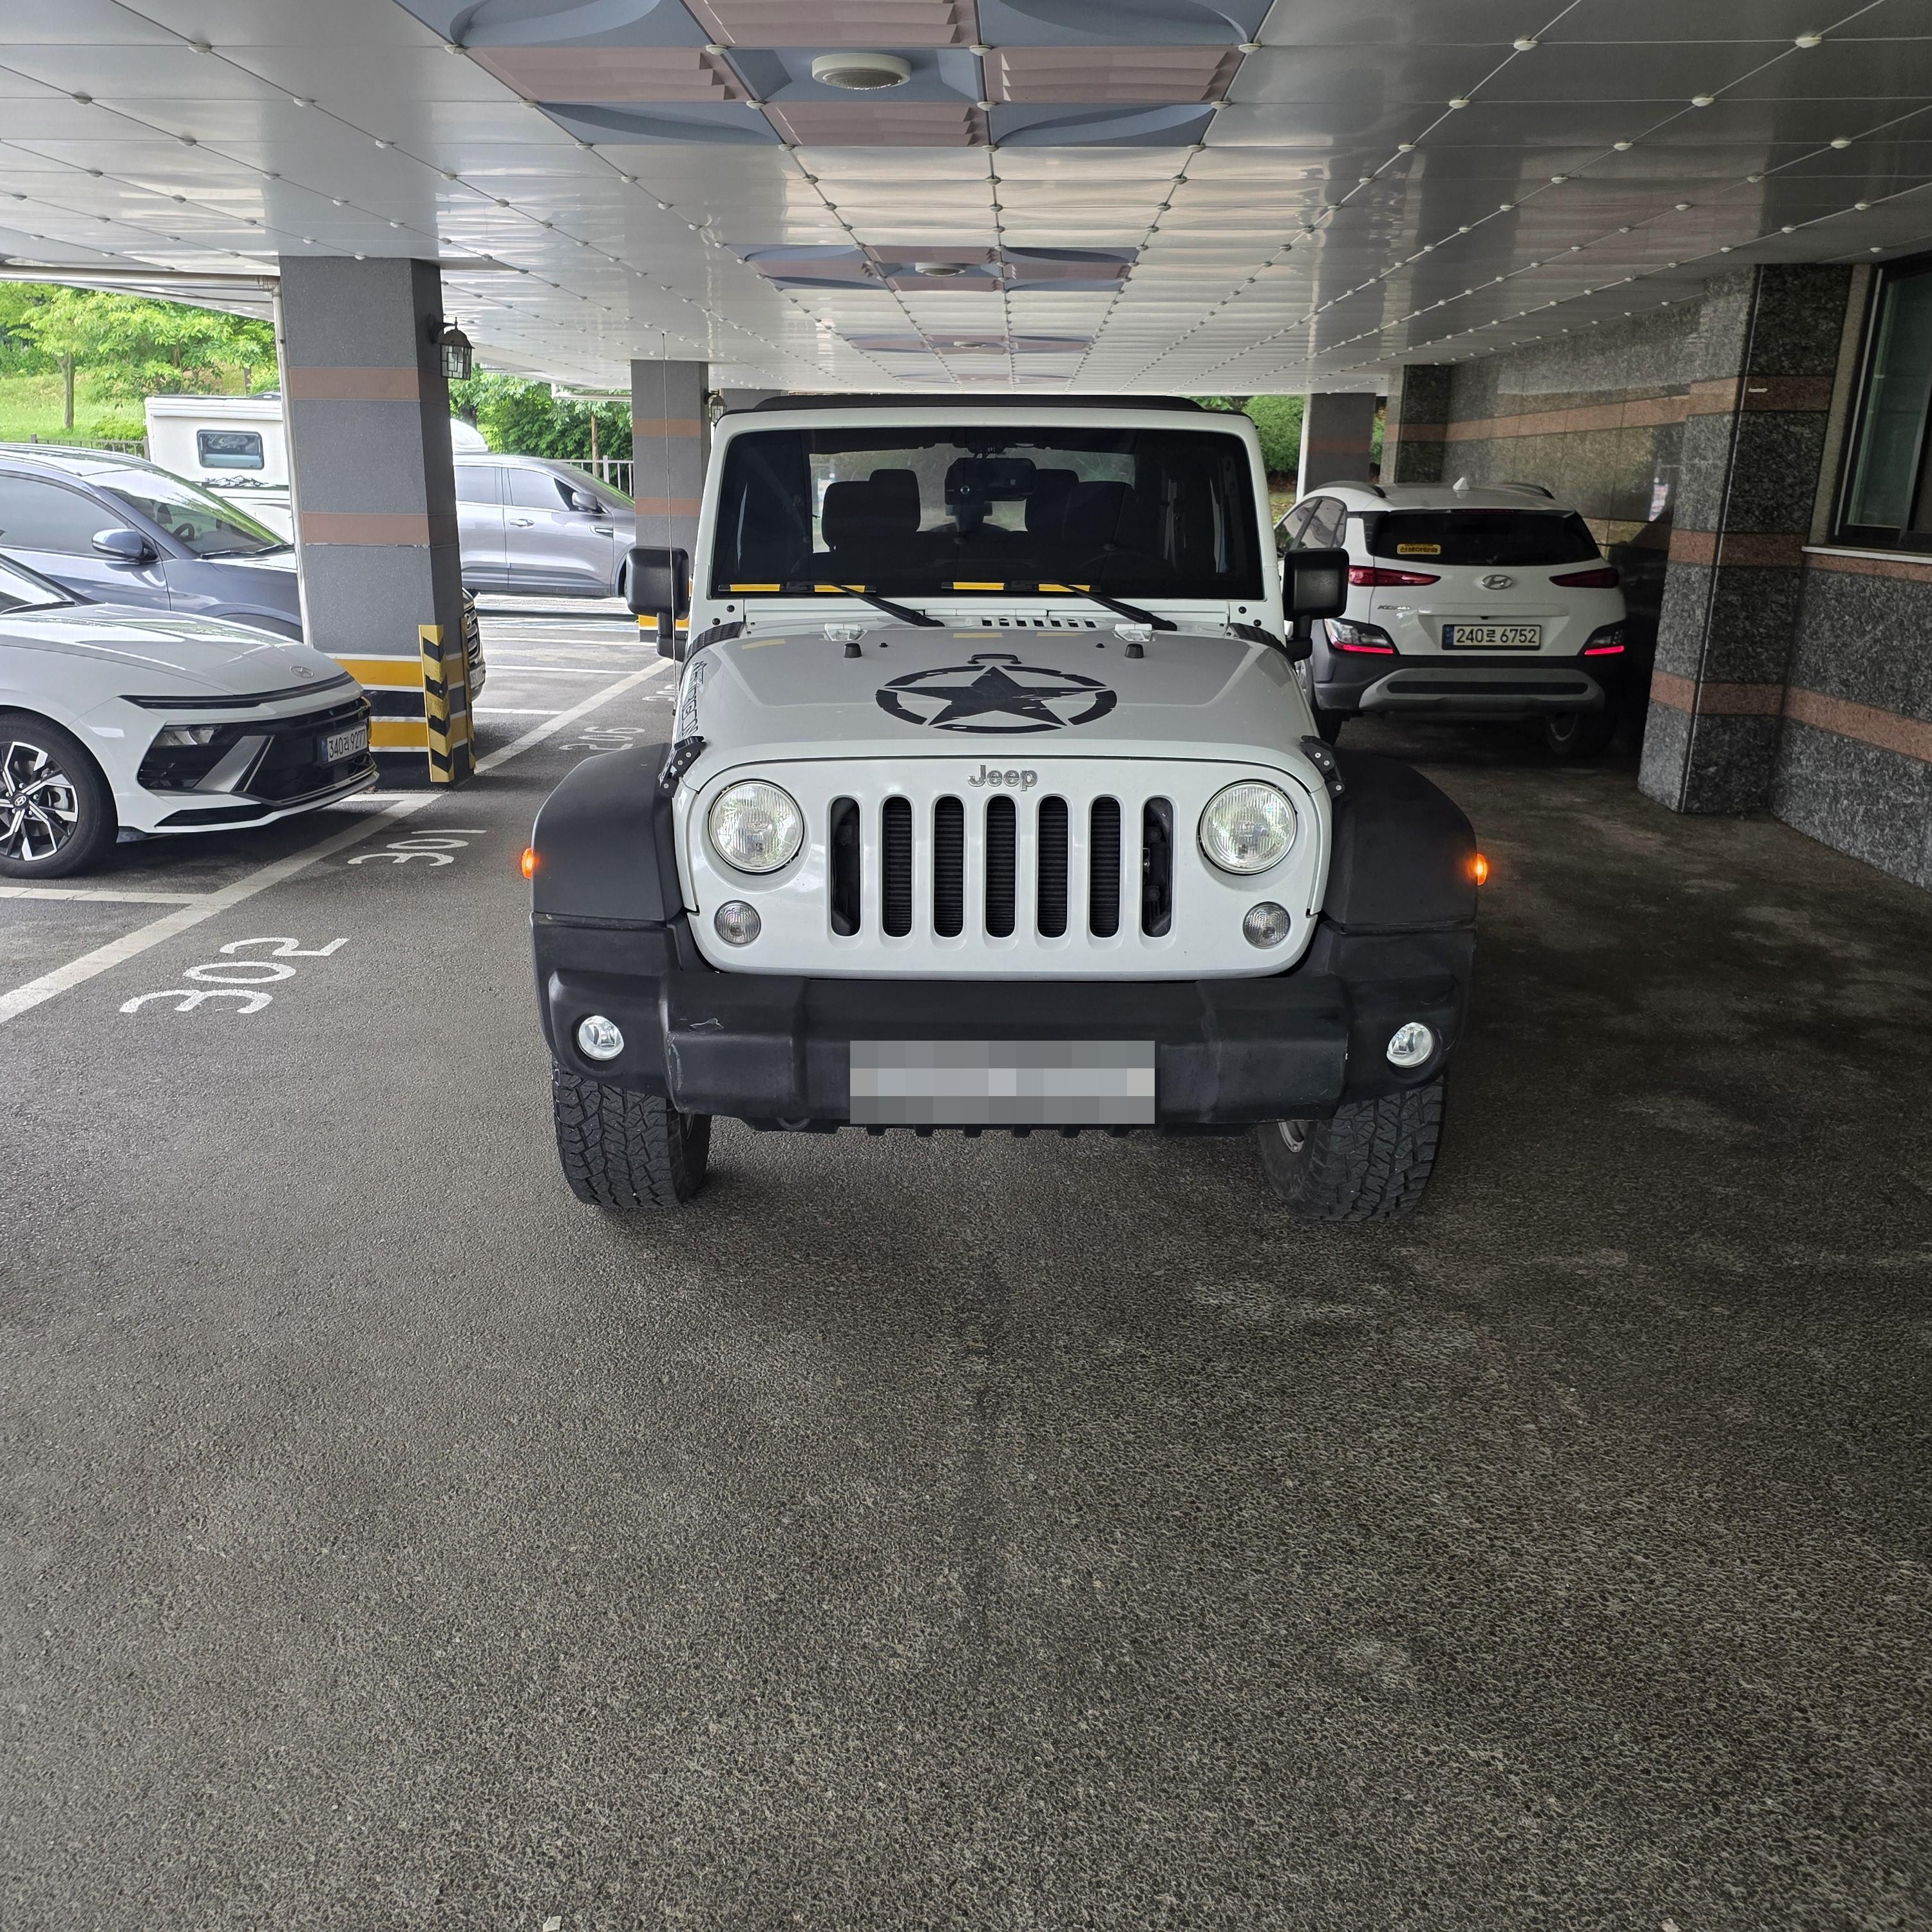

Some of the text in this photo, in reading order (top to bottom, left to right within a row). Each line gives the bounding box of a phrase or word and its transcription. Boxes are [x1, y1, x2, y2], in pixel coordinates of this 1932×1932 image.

[1456, 629, 1537, 643] 240로 6752
[350, 728, 365, 751] 9277
[558, 726, 645, 750] 206
[967, 764, 1037, 791] Jeep
[348, 829, 487, 866] 301
[119, 937, 350, 1013] 302
